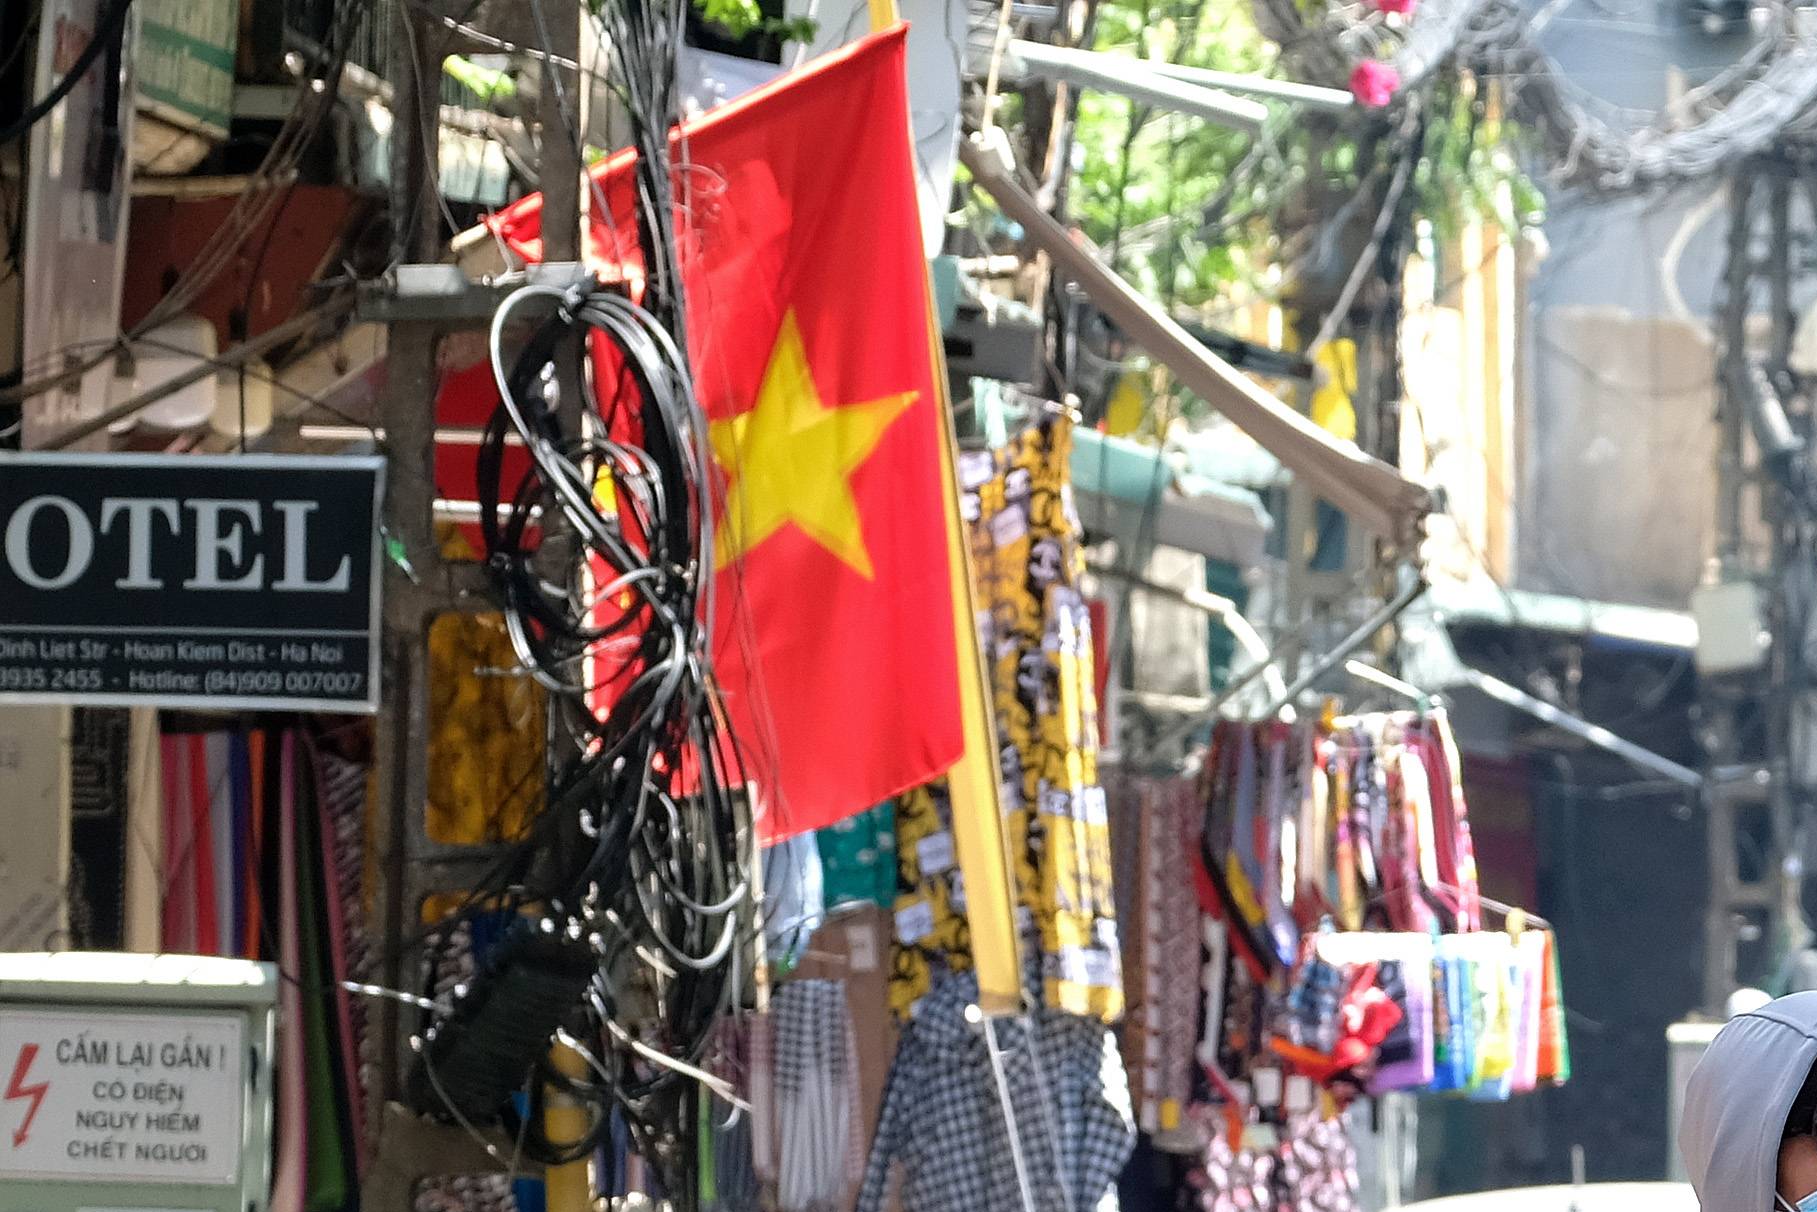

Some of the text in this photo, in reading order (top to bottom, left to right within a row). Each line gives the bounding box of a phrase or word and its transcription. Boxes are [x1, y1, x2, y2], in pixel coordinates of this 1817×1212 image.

[5, 494, 350, 592] OTEL
[124, 640, 175, 661] Hoan
[227, 640, 266, 662] Dist
[75, 1109, 138, 1129] NGUY
